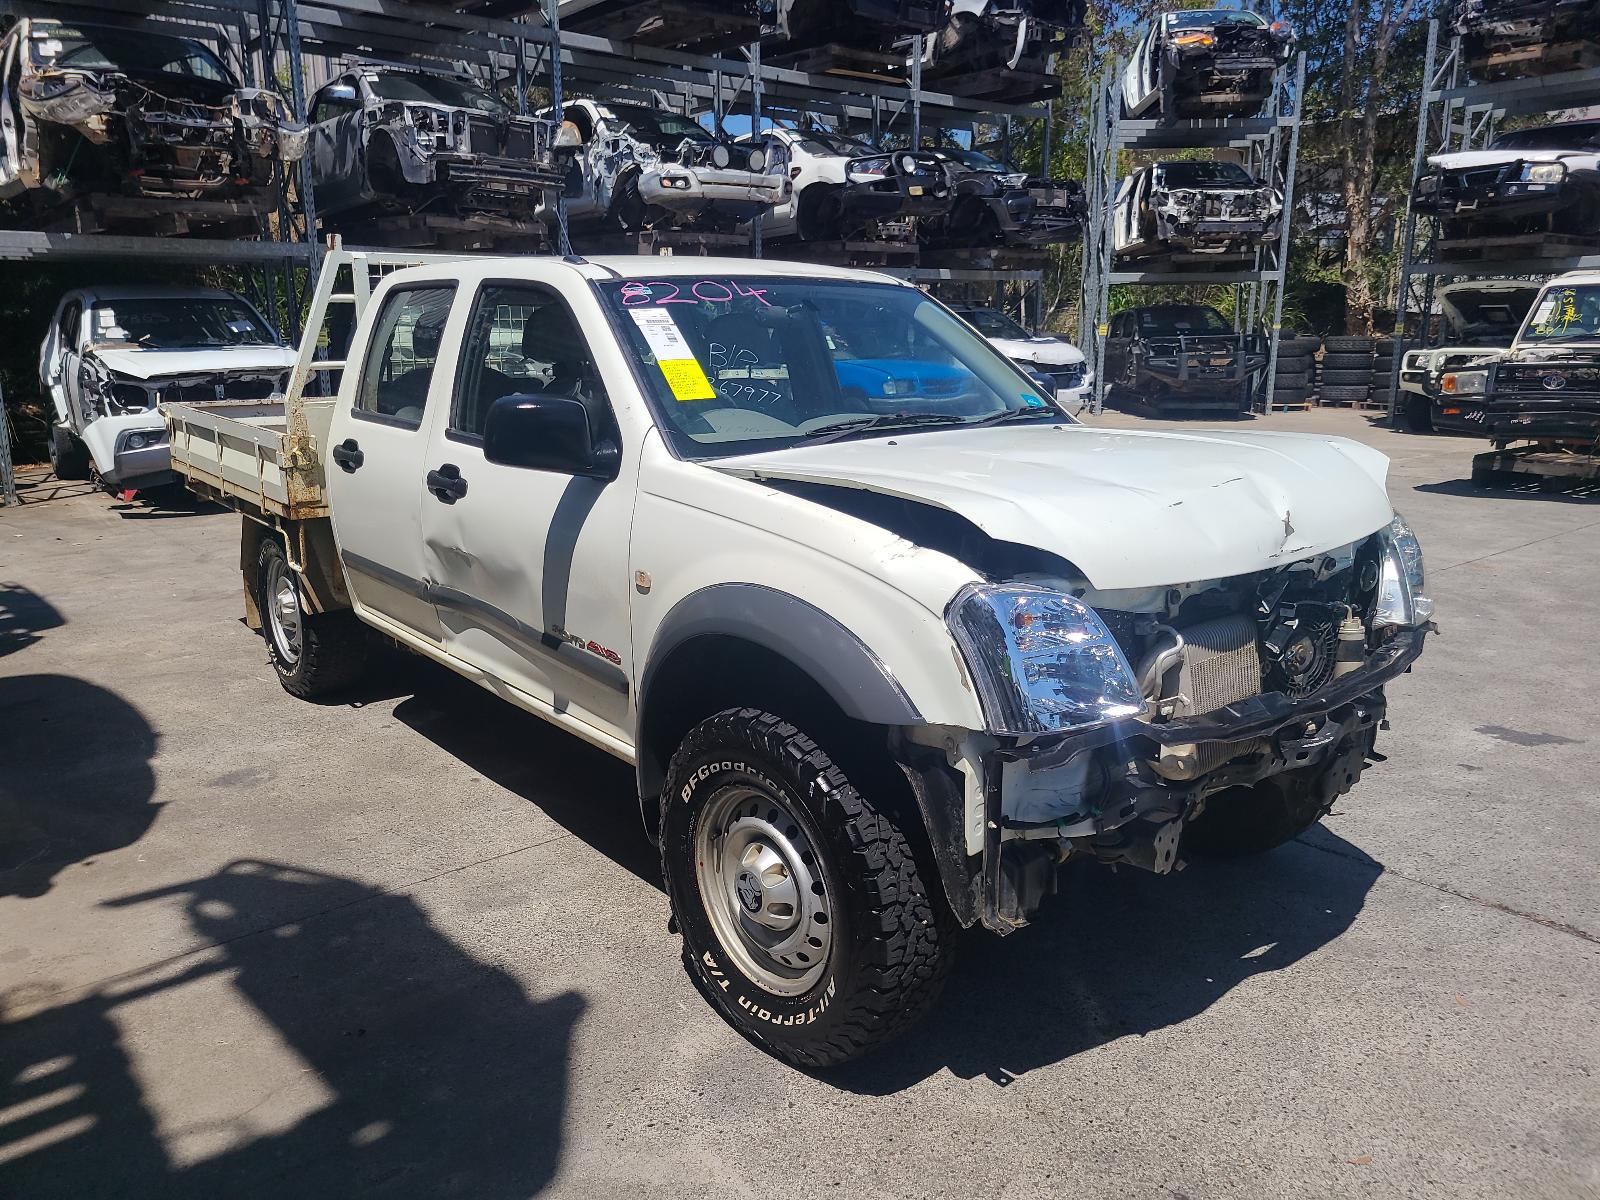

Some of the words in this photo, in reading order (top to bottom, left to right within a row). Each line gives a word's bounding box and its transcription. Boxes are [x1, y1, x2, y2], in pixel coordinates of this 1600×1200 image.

[620, 281, 772, 306] 8204
[681, 761, 791, 804] BFGoodrich
[702, 950, 731, 993] T/A
[738, 973, 837, 1026] All-Terrain
